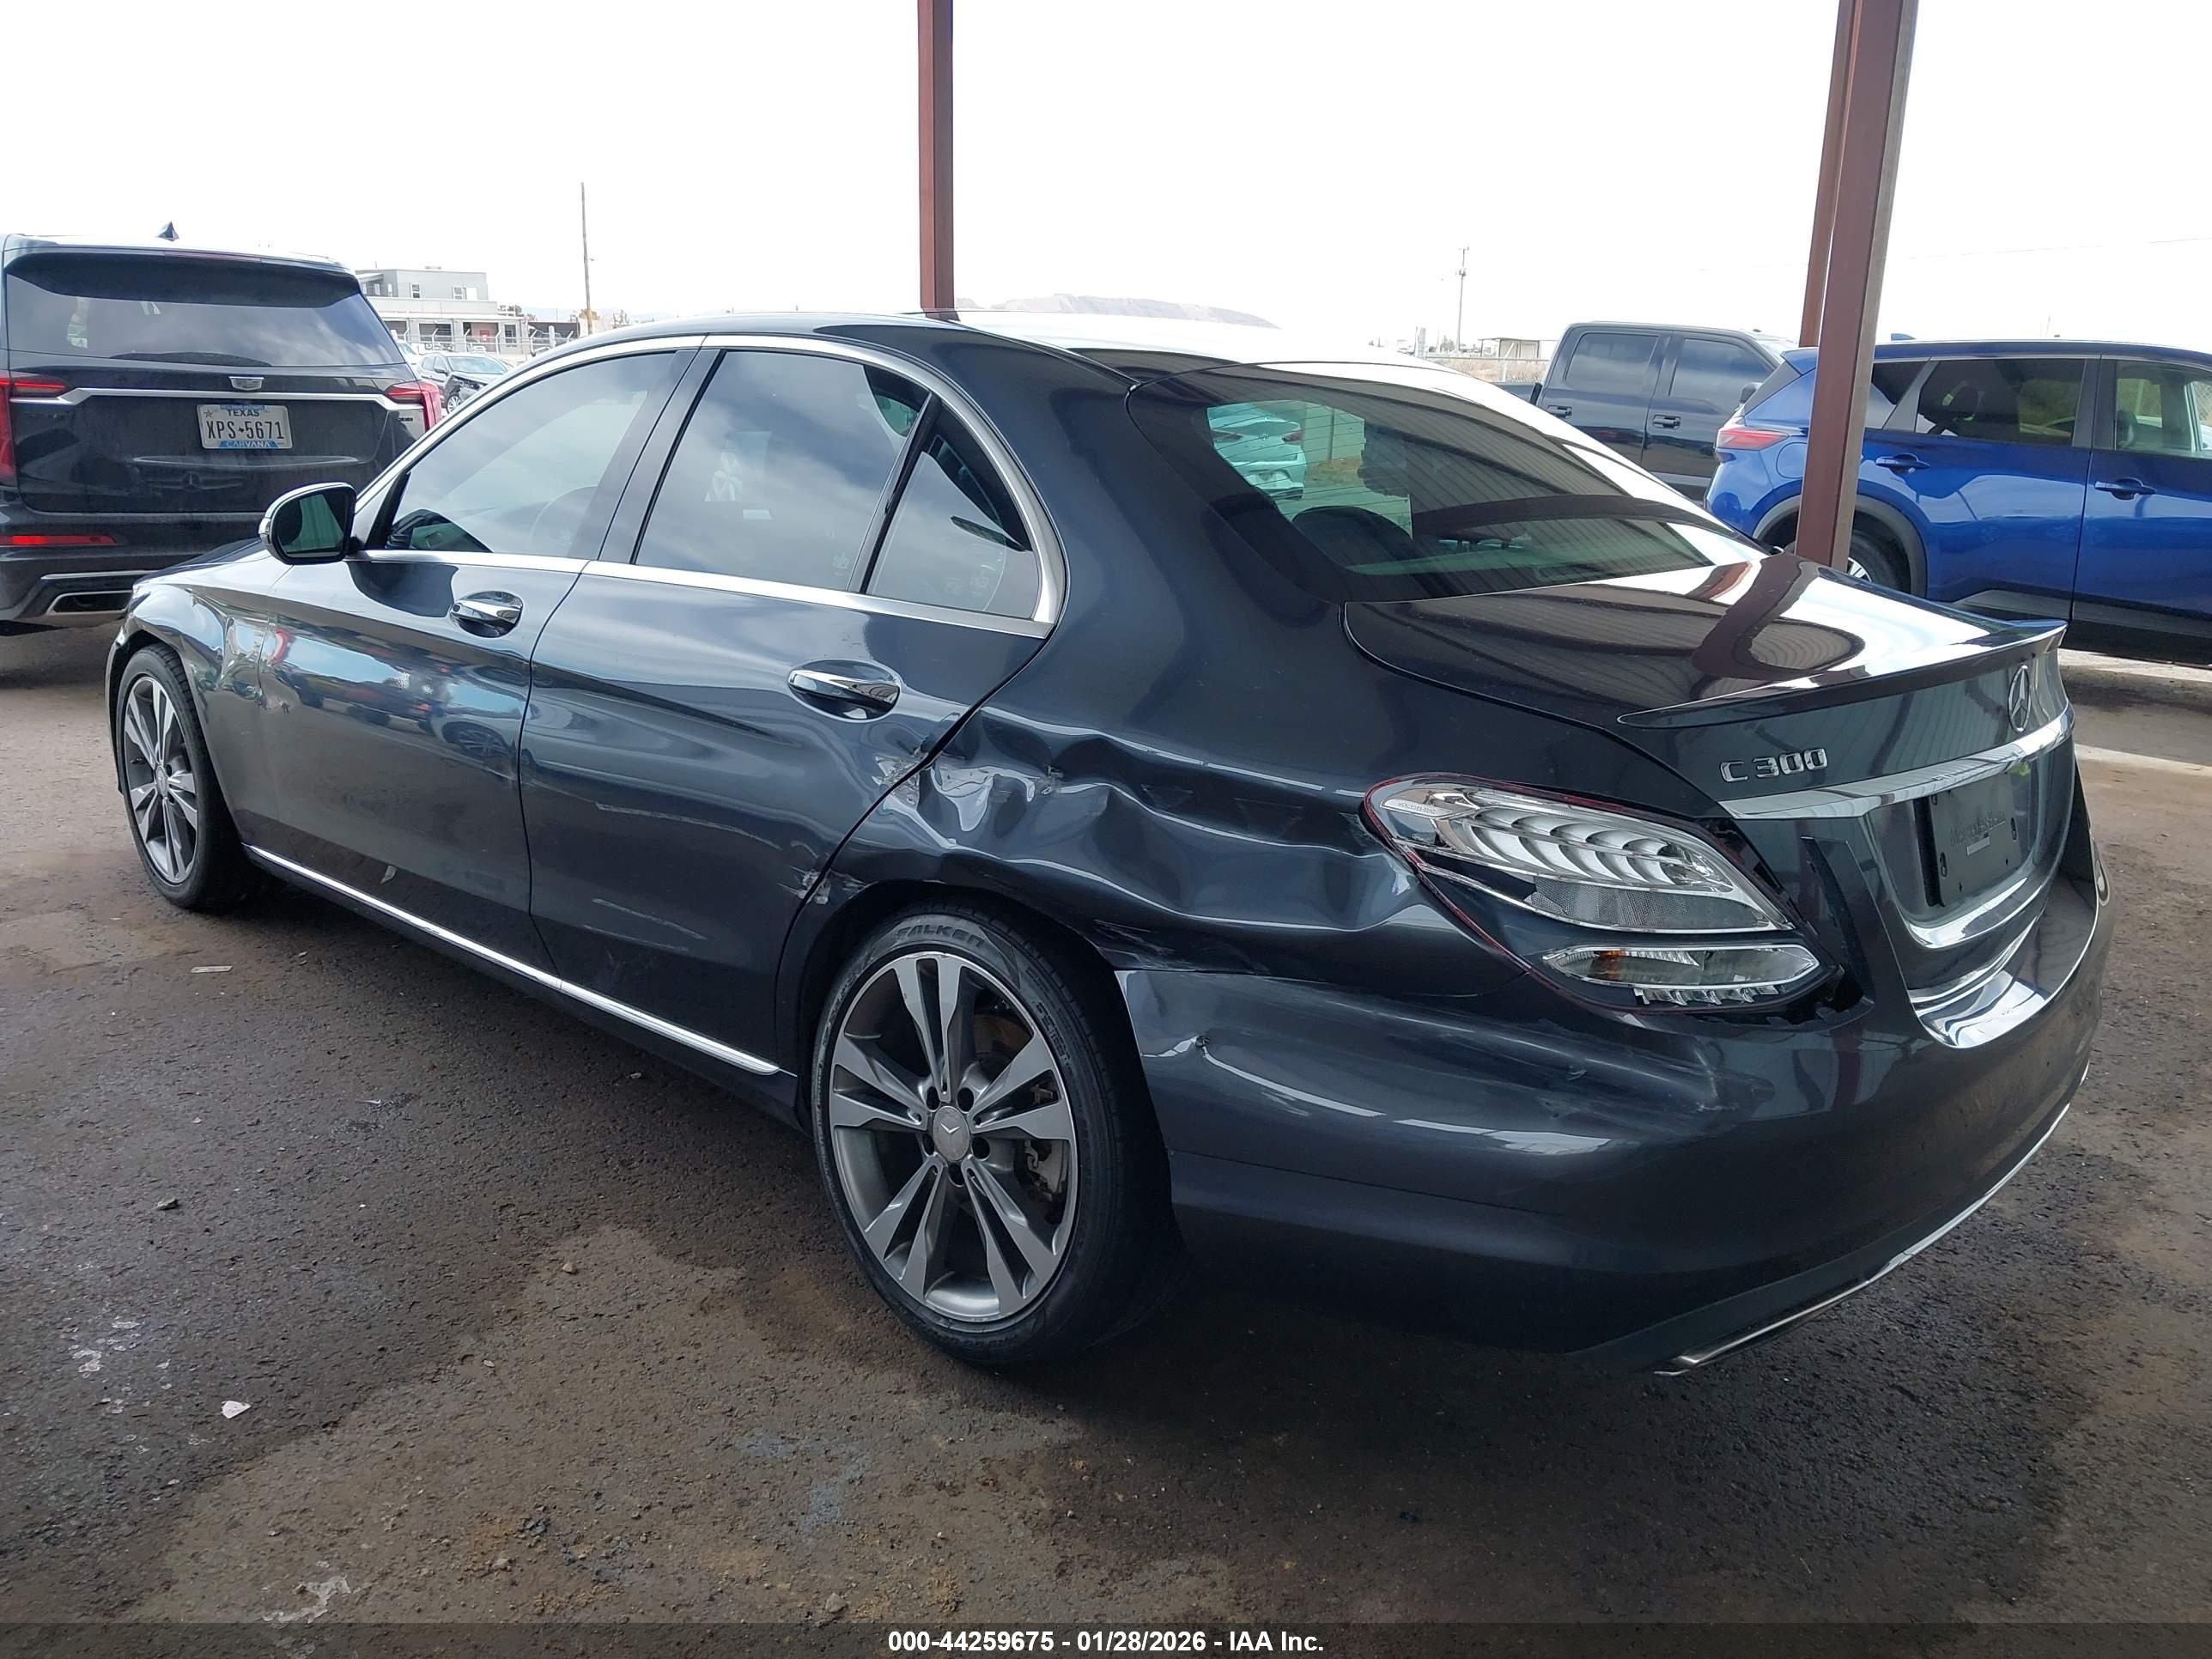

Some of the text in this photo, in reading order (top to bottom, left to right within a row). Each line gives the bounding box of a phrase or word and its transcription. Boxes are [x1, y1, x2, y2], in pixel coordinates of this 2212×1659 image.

[227, 409, 260, 417] TEXAS
[206, 421, 285, 440] XPS 5671
[1720, 748, 1828, 782] C 300
[896, 924, 986, 947] FALKEN
